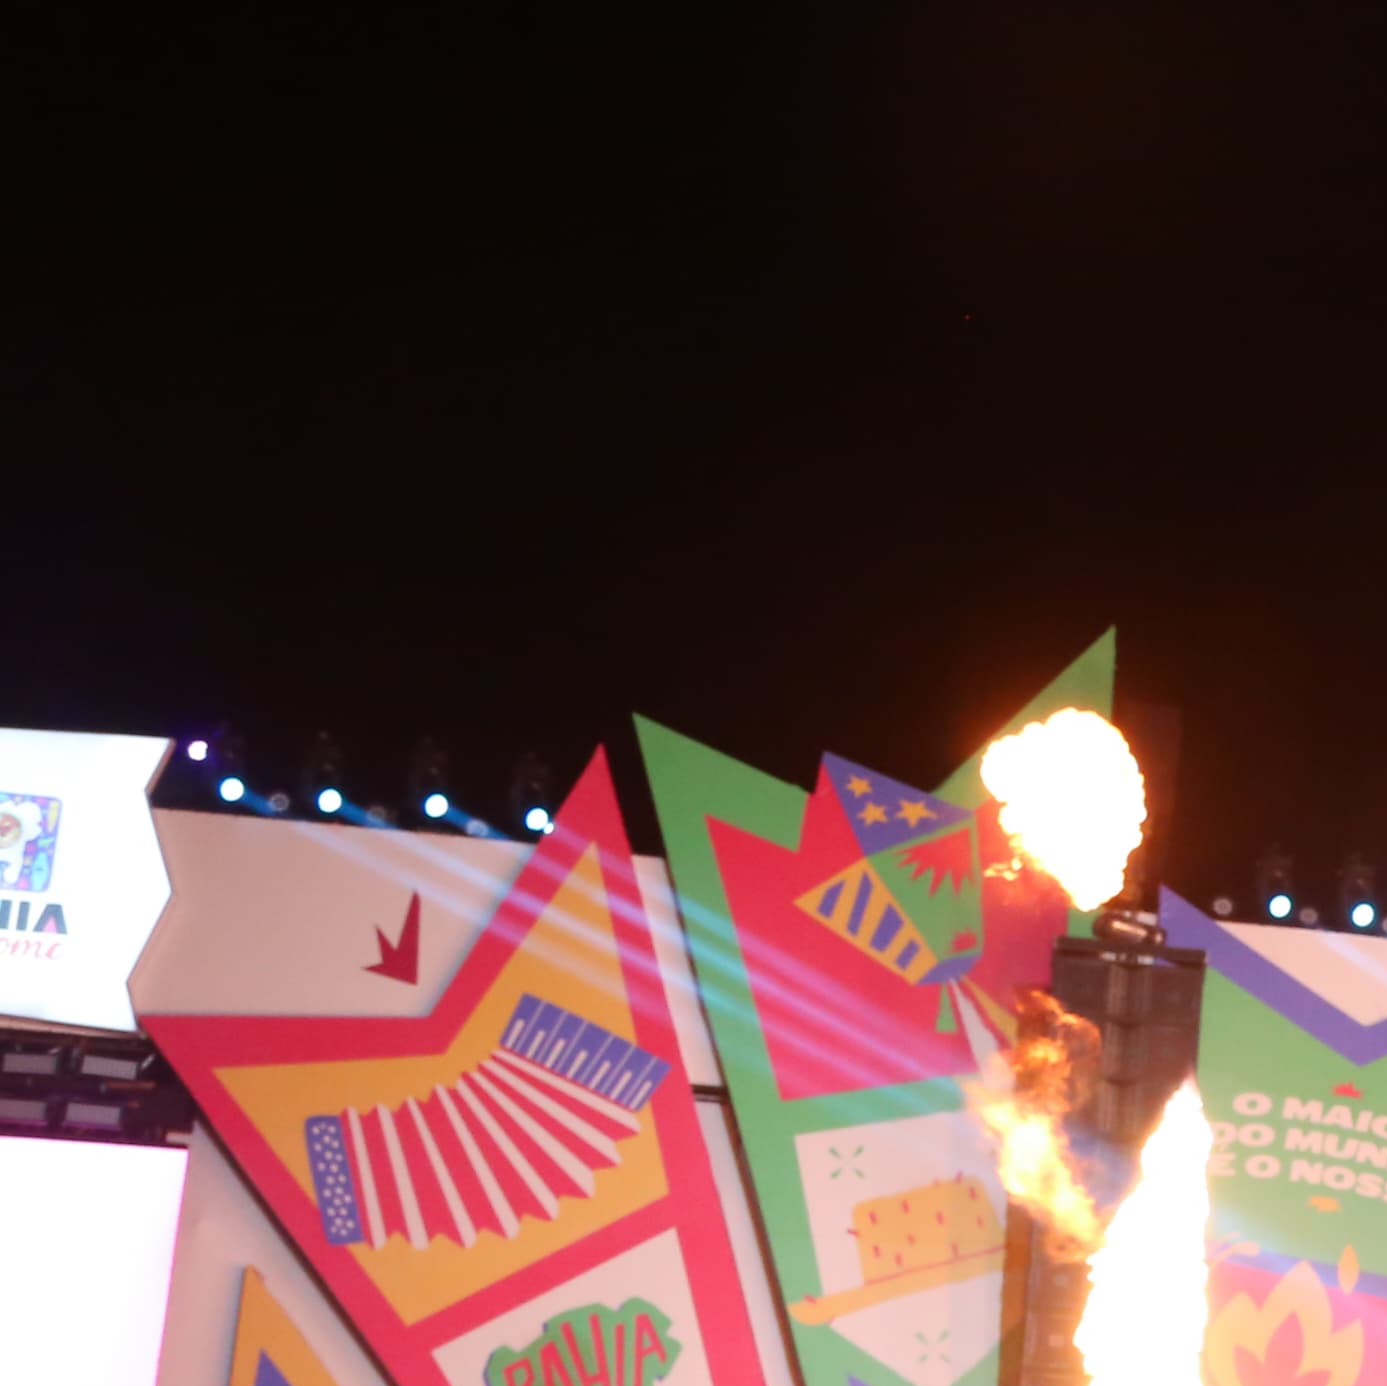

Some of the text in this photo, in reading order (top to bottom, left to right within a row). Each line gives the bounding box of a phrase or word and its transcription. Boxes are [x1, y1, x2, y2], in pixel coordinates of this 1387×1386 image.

[1232, 1091, 1273, 1117] O
[1211, 1121, 1275, 1148] DO
[1244, 1153, 1282, 1179] O
